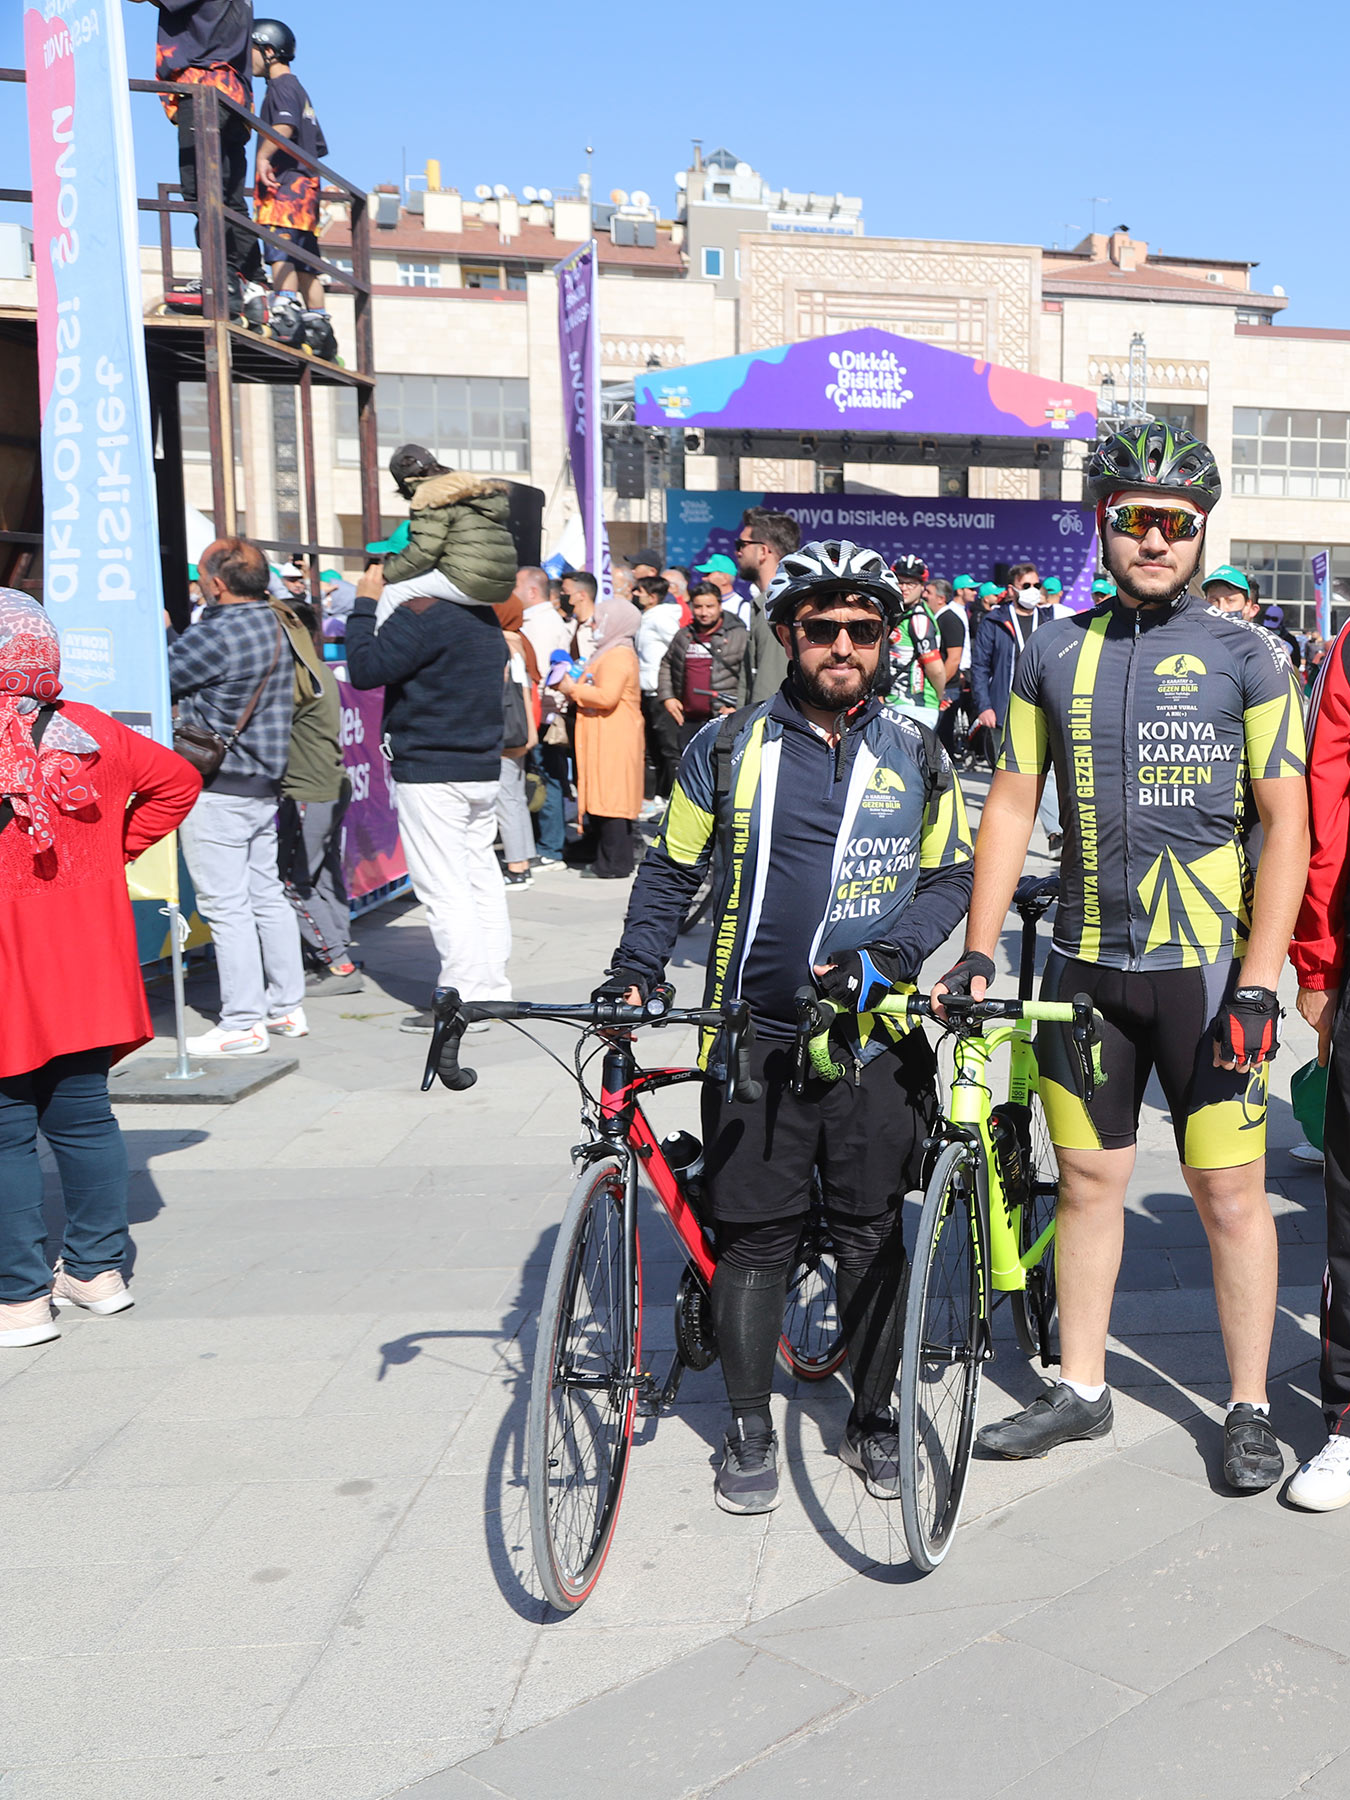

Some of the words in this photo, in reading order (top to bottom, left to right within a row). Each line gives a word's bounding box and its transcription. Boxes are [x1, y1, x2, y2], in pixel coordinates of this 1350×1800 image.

[773, 506, 834, 529] onya
[837, 508, 910, 527] bisiklet
[912, 511, 995, 529] festivali
[1157, 685, 1179, 693] GEZEN
[1180, 684, 1199, 693] BİLİR
[1067, 697, 1093, 740] BİLİR
[1138, 722, 1216, 740] KONYA
[1138, 744, 1235, 762] KARATAY
[1073, 745, 1095, 798] GEZEN
[1138, 766, 1212, 784] GEZEN
[862, 801, 884, 809] GEZEN
[885, 800, 902, 809] BİLİR
[1138, 784, 1197, 806] BİLİR
[1078, 802, 1098, 871] KARATAY
[845, 837, 911, 858] KONYA
[1082, 875, 1100, 925] KONYA
